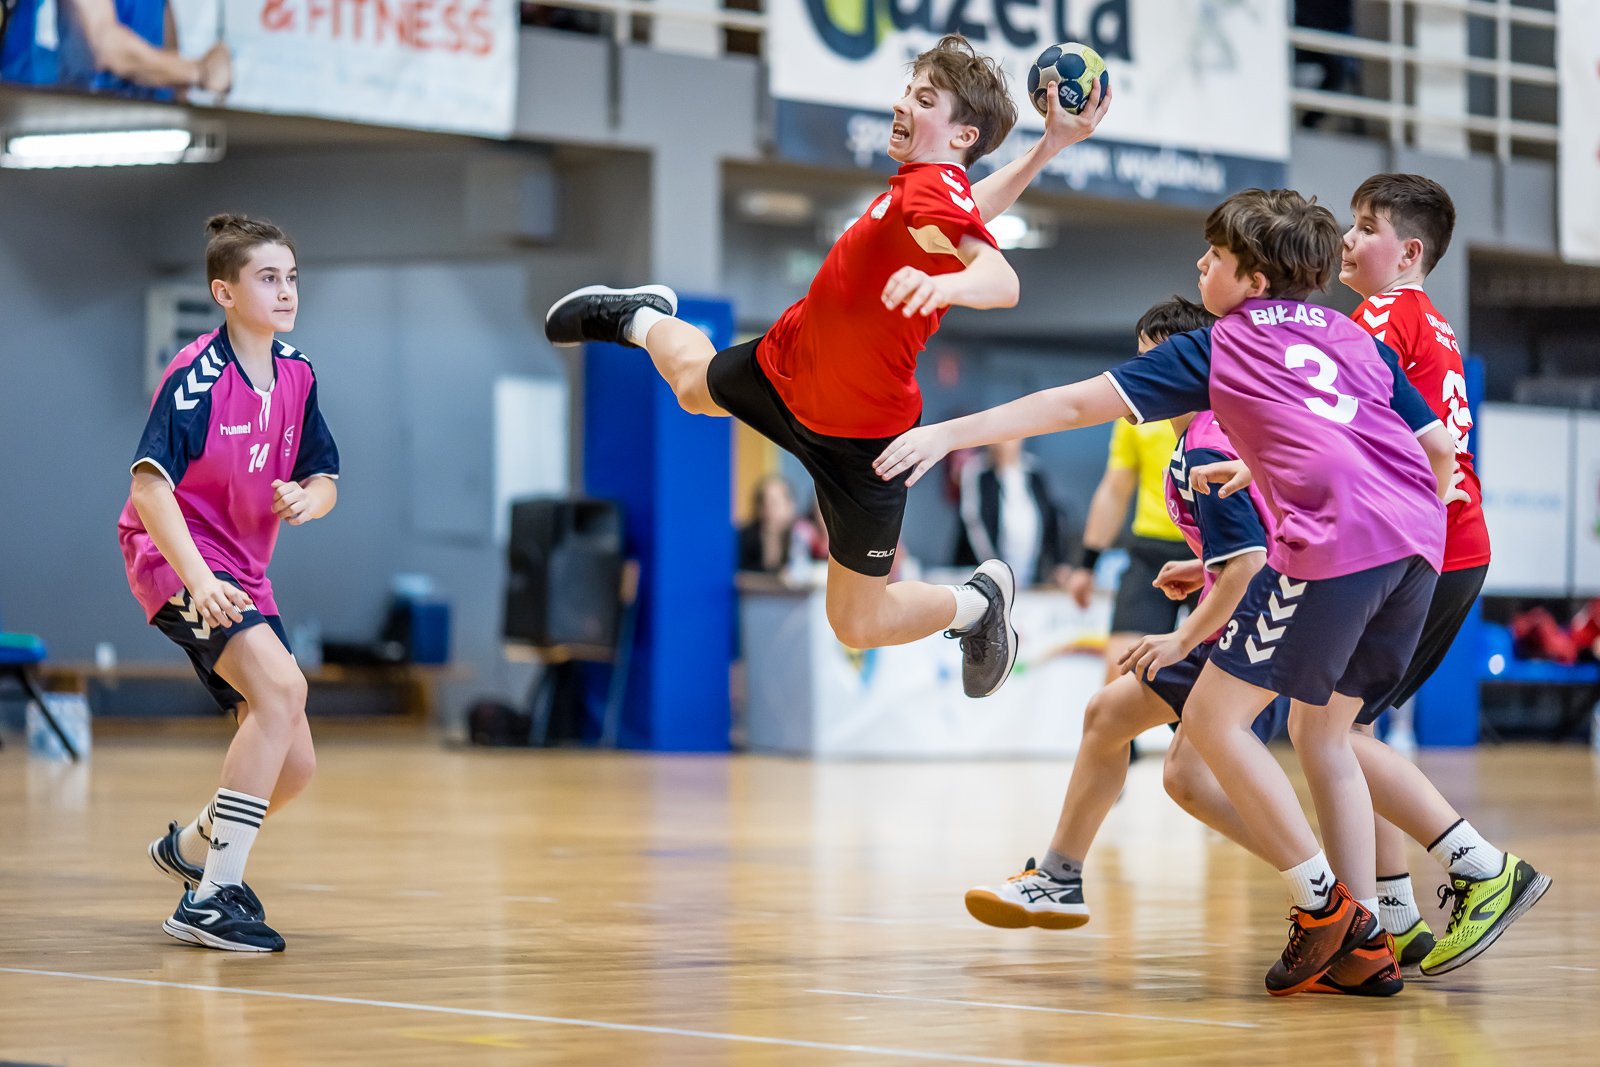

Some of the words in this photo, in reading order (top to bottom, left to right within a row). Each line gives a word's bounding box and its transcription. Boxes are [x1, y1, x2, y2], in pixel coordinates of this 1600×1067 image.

[260, 0, 295, 32] &
[308, 0, 493, 57] FITNESS
[1249, 303, 1328, 328] BIŁAS
[1284, 343, 1359, 424] 3
[219, 421, 252, 436] hummel
[248, 443, 270, 473] 14
[1218, 619, 1239, 650] 3
